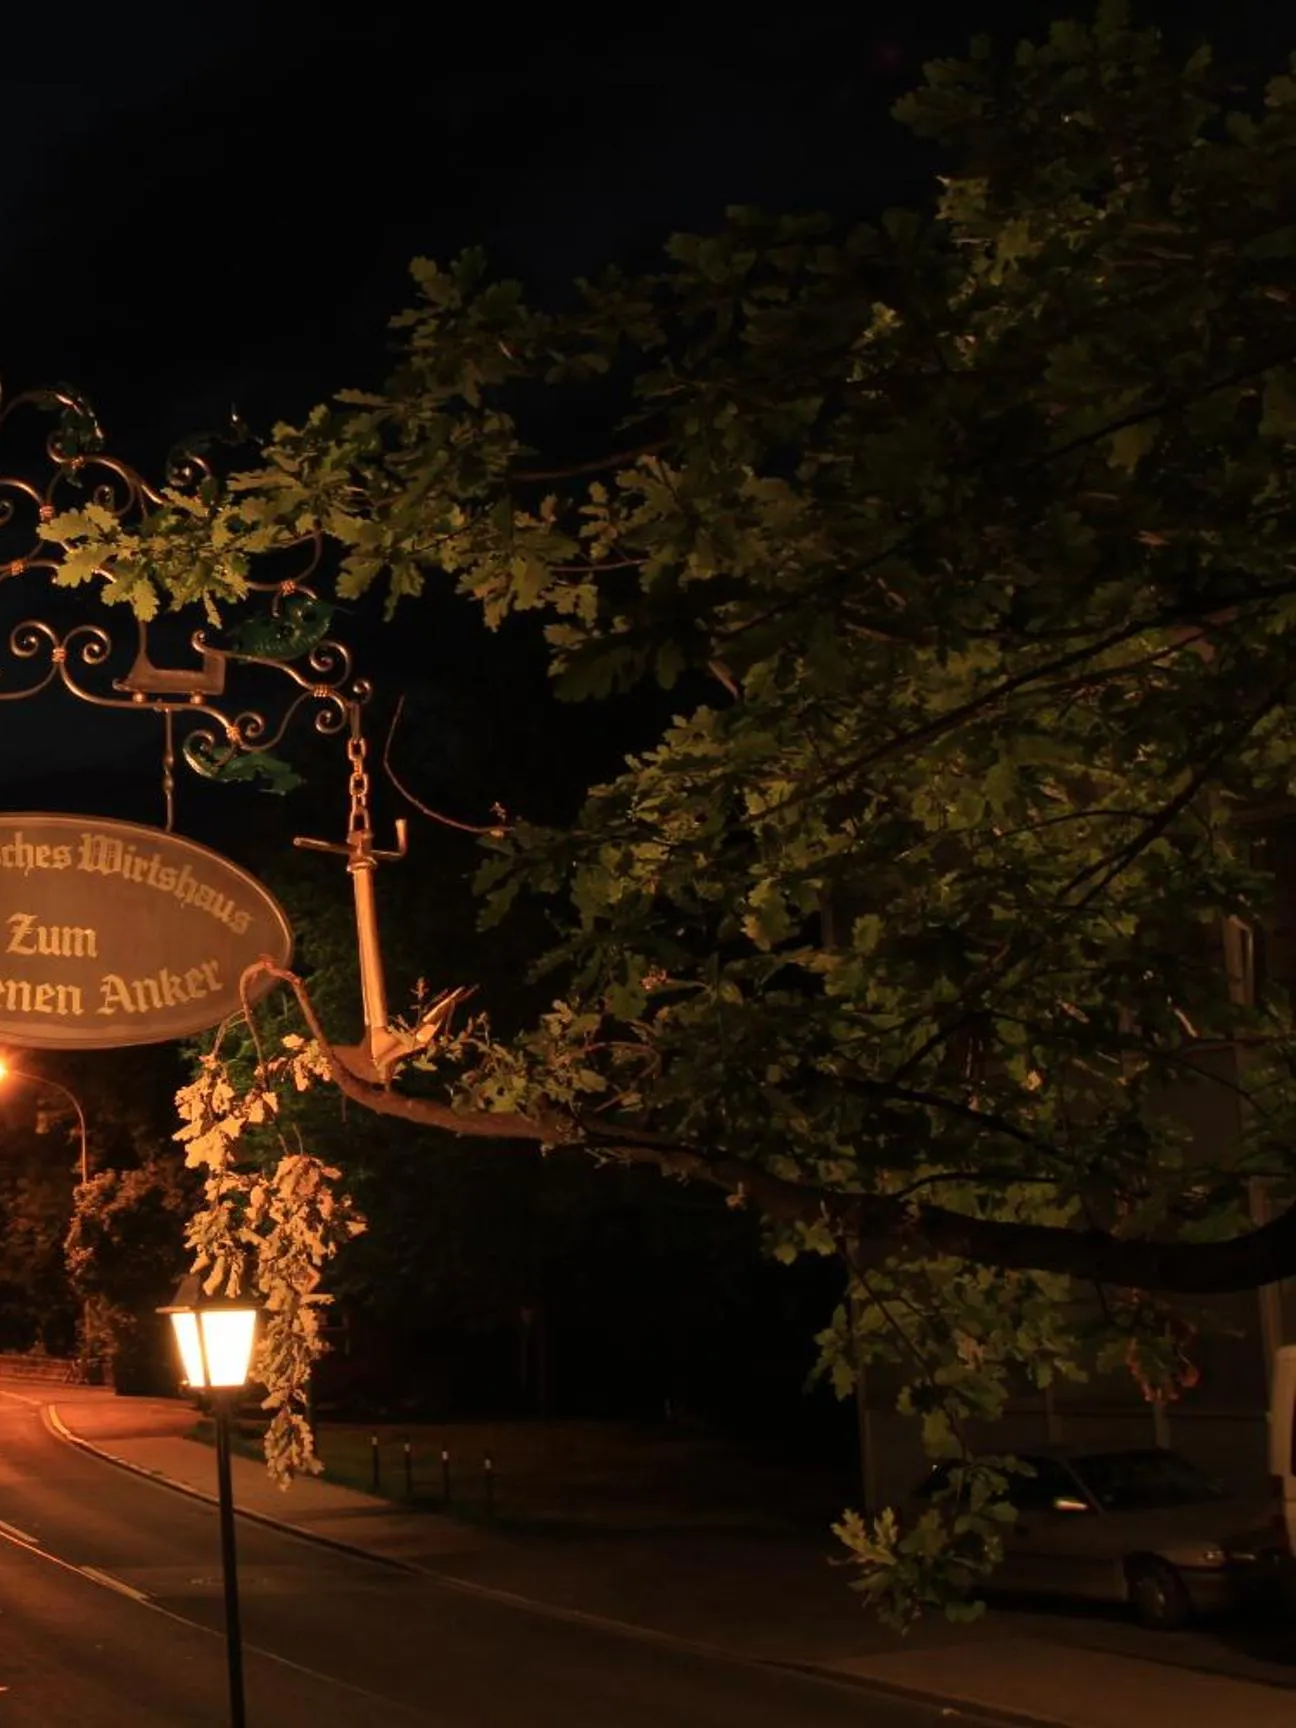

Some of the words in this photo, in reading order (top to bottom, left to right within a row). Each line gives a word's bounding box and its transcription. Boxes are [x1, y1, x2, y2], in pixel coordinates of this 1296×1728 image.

[77, 833, 253, 934] Wirtshaus
[6, 912, 98, 958] Zum
[97, 960, 223, 1015] Anker
